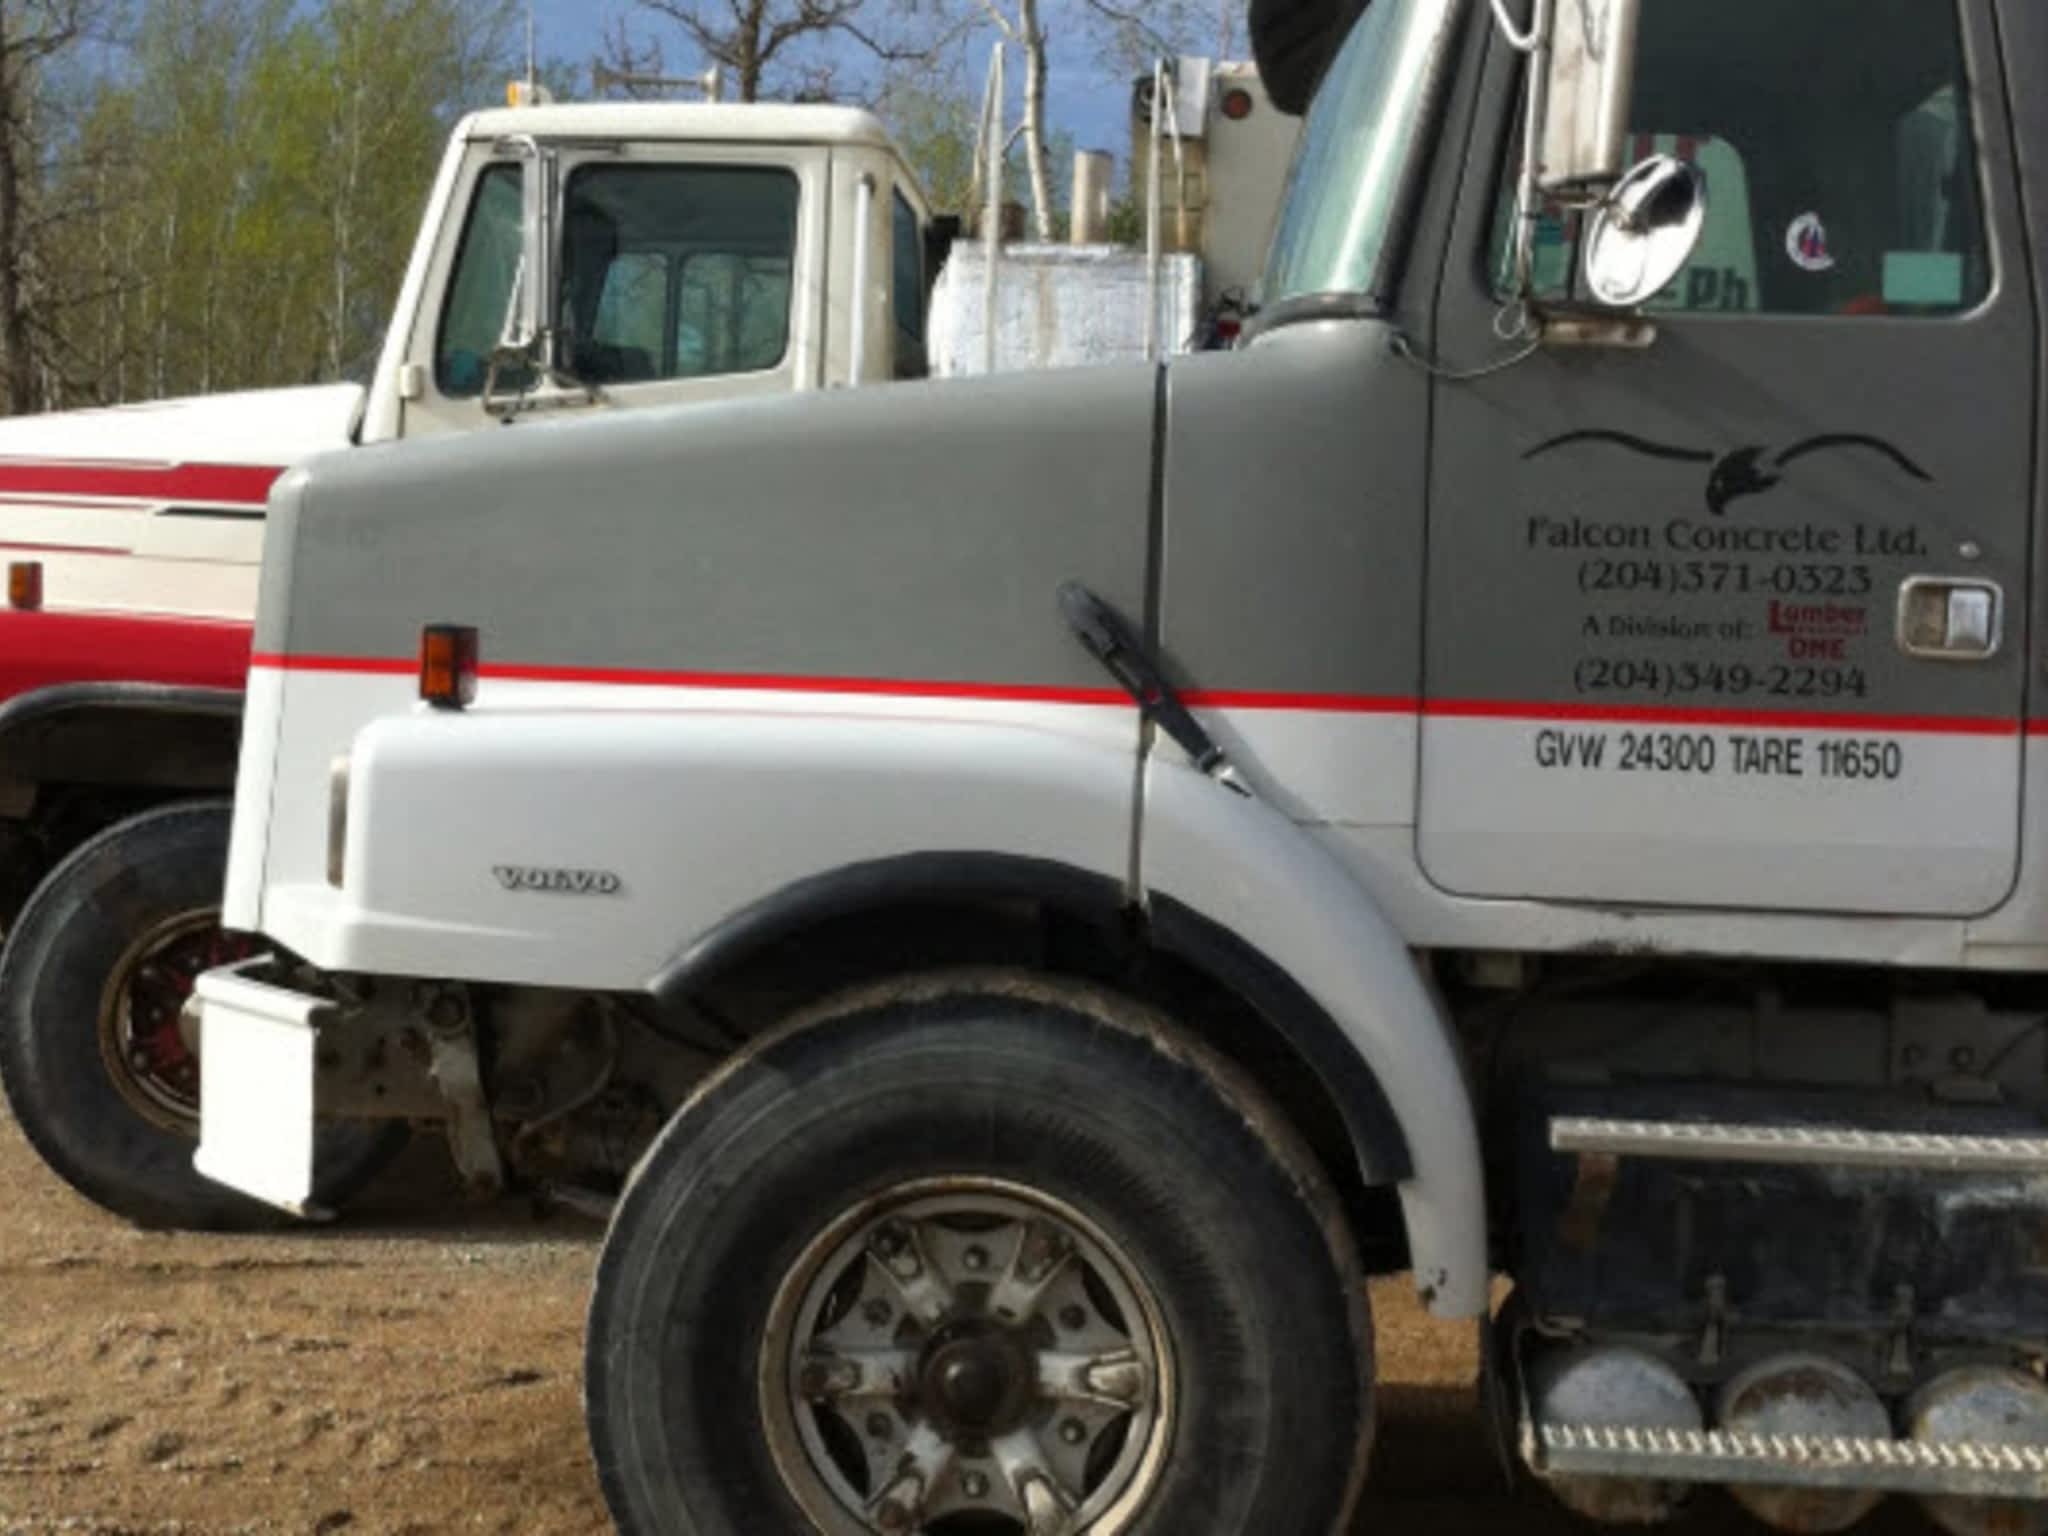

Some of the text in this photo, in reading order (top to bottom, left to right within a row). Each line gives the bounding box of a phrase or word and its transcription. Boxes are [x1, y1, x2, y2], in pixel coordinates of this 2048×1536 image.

[1527, 516, 1928, 556] Falcon Concrete Ltd.
[1577, 561, 1872, 596] (204)371-0323
[1581, 615, 1600, 636] A
[1608, 616, 1711, 638] Division
[1768, 600, 1867, 632] Lumber
[1574, 660, 1867, 698] (204)349-2294
[1536, 730, 1902, 779] GVW 24300 TARE 11650
[492, 865, 621, 894] VOLVO
